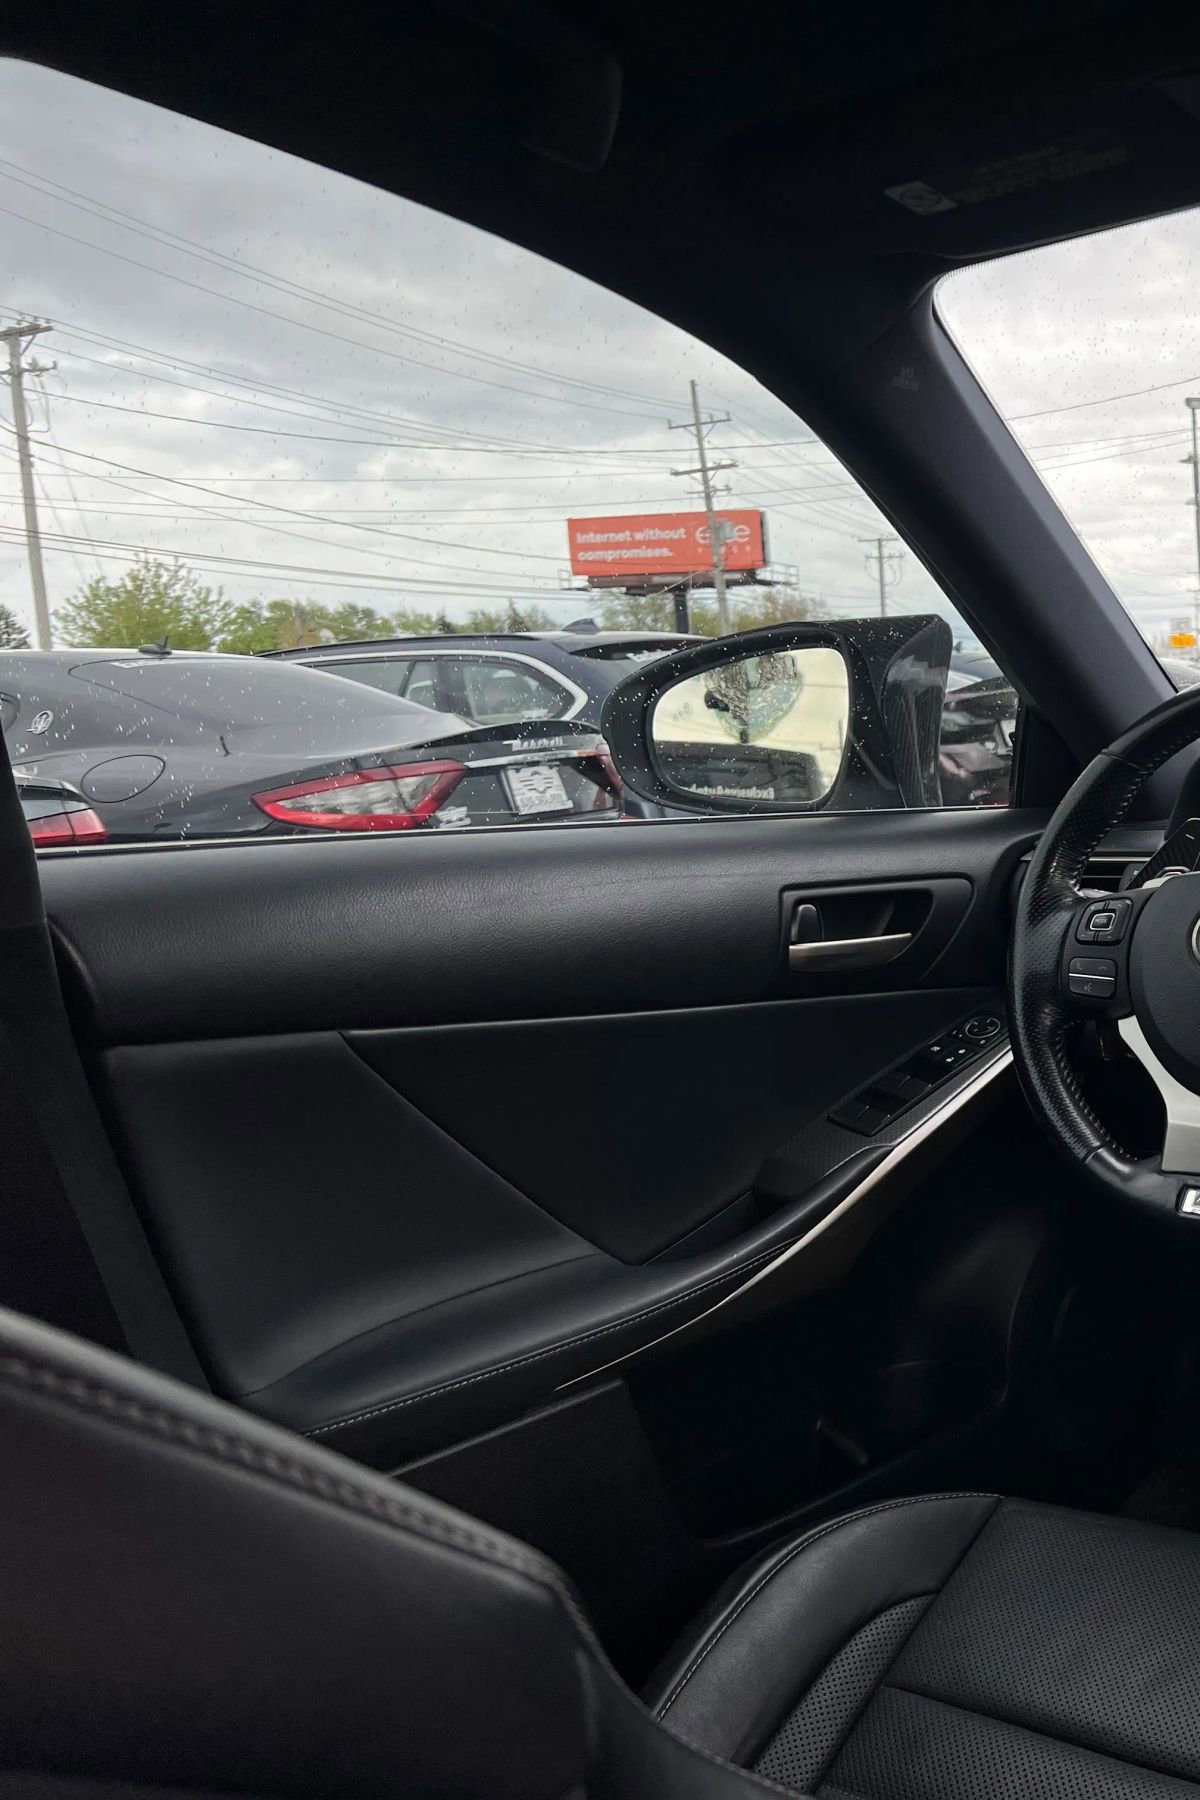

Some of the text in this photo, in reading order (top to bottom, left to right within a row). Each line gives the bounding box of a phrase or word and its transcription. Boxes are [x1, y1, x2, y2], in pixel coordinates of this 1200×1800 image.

[576, 527, 687, 544] Internet without
[577, 546, 674, 562] compromises.
